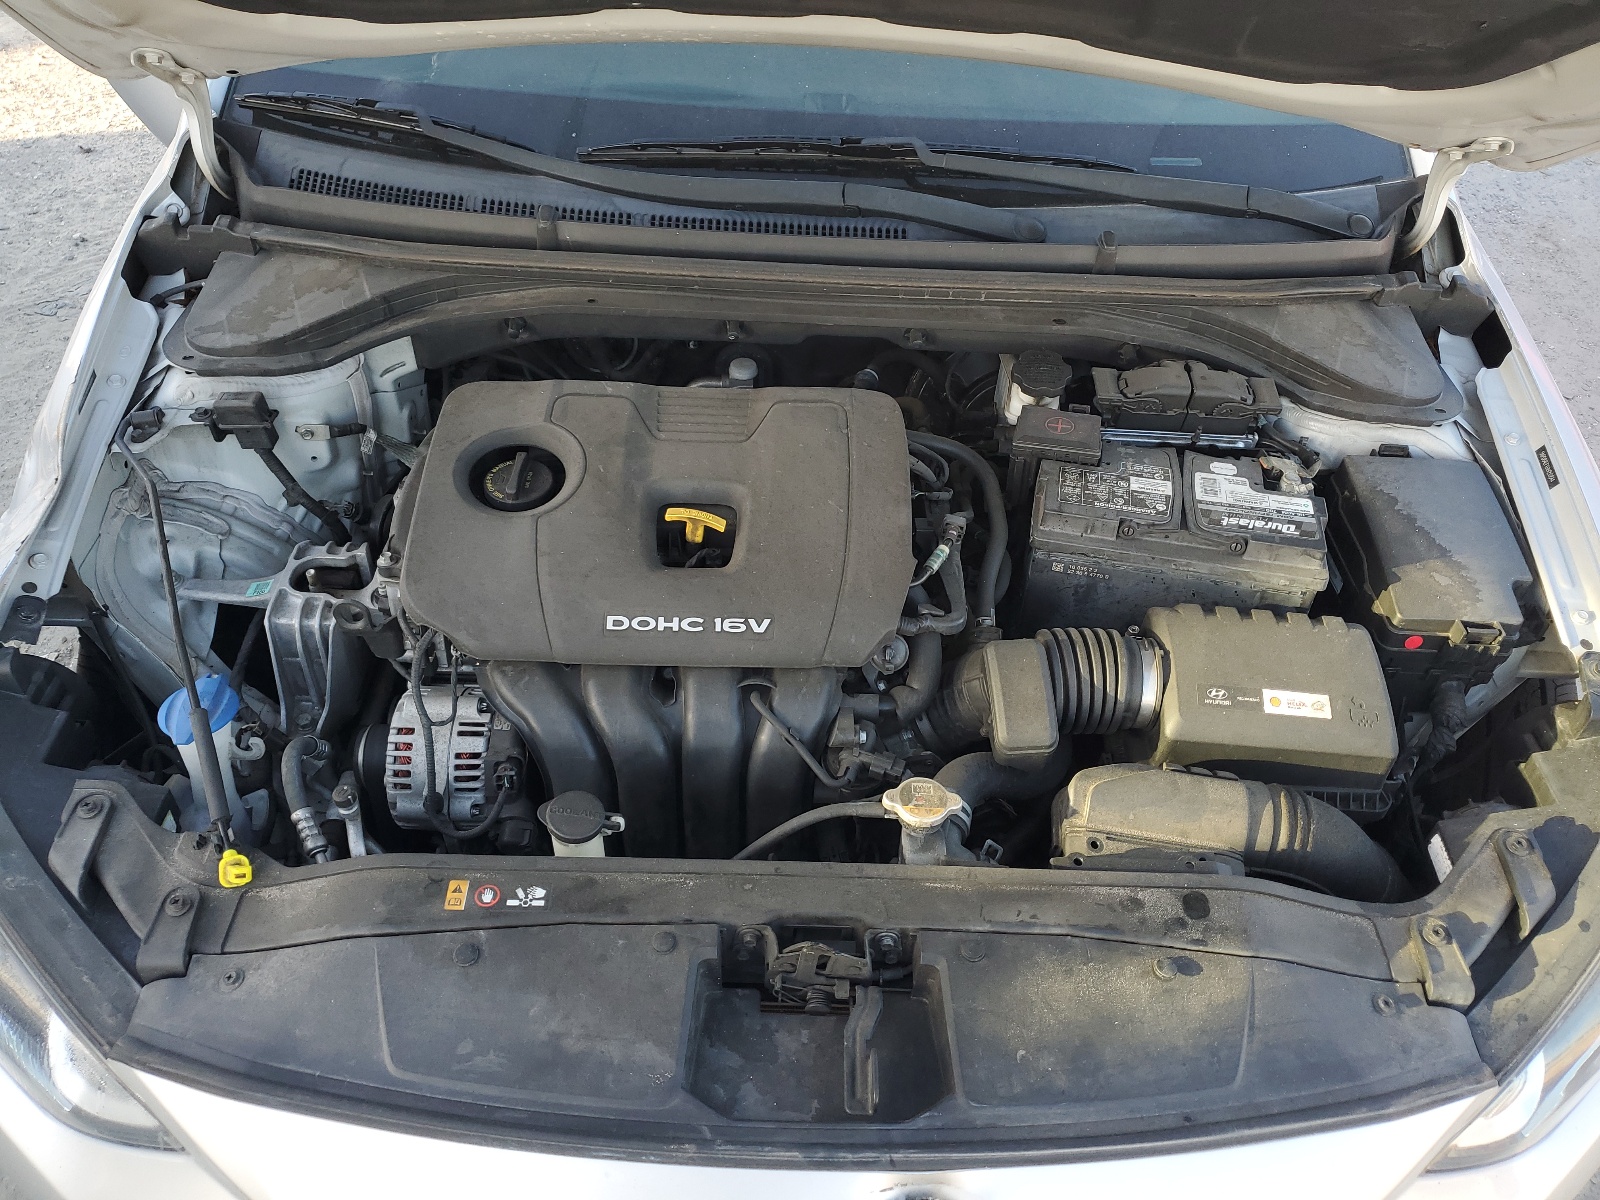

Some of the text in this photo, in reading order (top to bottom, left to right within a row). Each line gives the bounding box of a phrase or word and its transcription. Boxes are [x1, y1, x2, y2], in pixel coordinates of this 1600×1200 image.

[1220, 516, 1300, 535] Duralast
[606, 615, 772, 634] DOHC 16V
[1204, 698, 1231, 706] HYUNDAI
